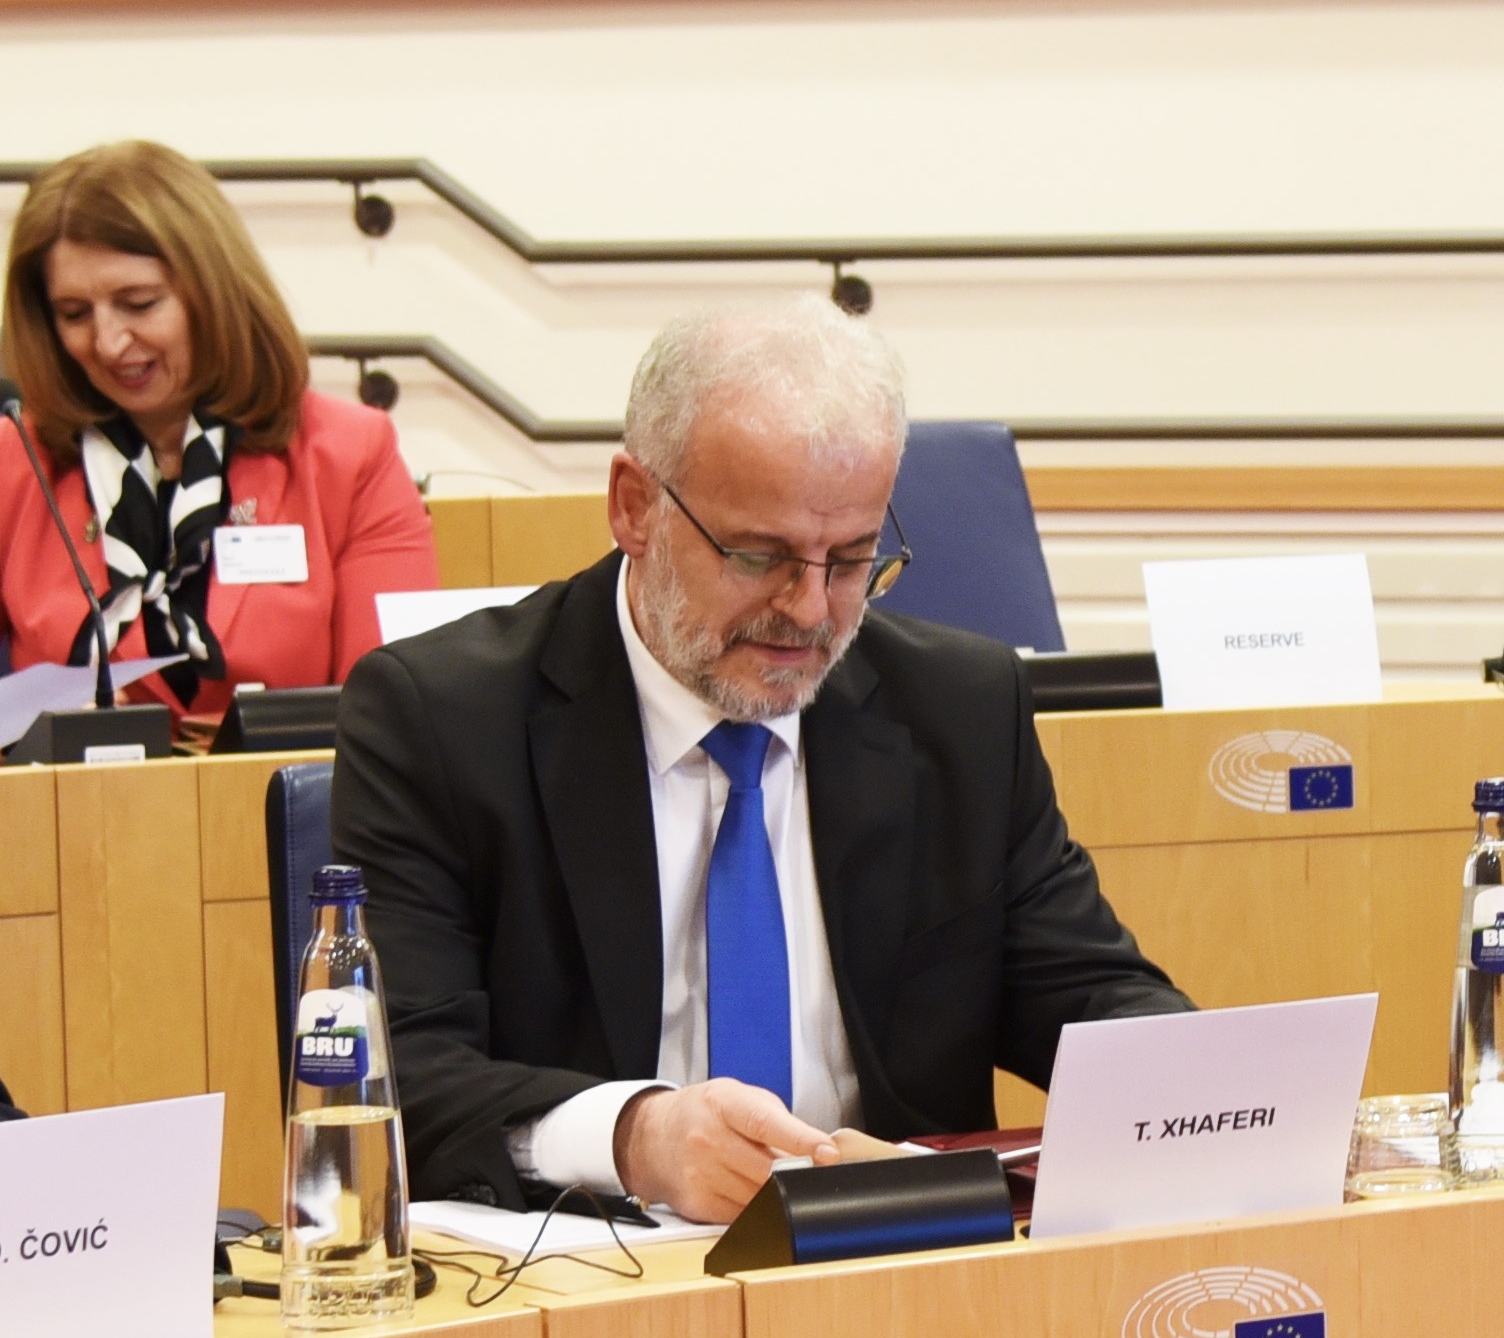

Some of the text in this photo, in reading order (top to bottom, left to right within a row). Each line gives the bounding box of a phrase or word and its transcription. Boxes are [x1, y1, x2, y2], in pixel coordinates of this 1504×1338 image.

[1224, 631, 1305, 651] RESERVE
[301, 1036, 354, 1057] BRU
[1134, 1106, 1277, 1143] T. XHAFERI
[19, 1217, 109, 1261] ČOVIĆ
